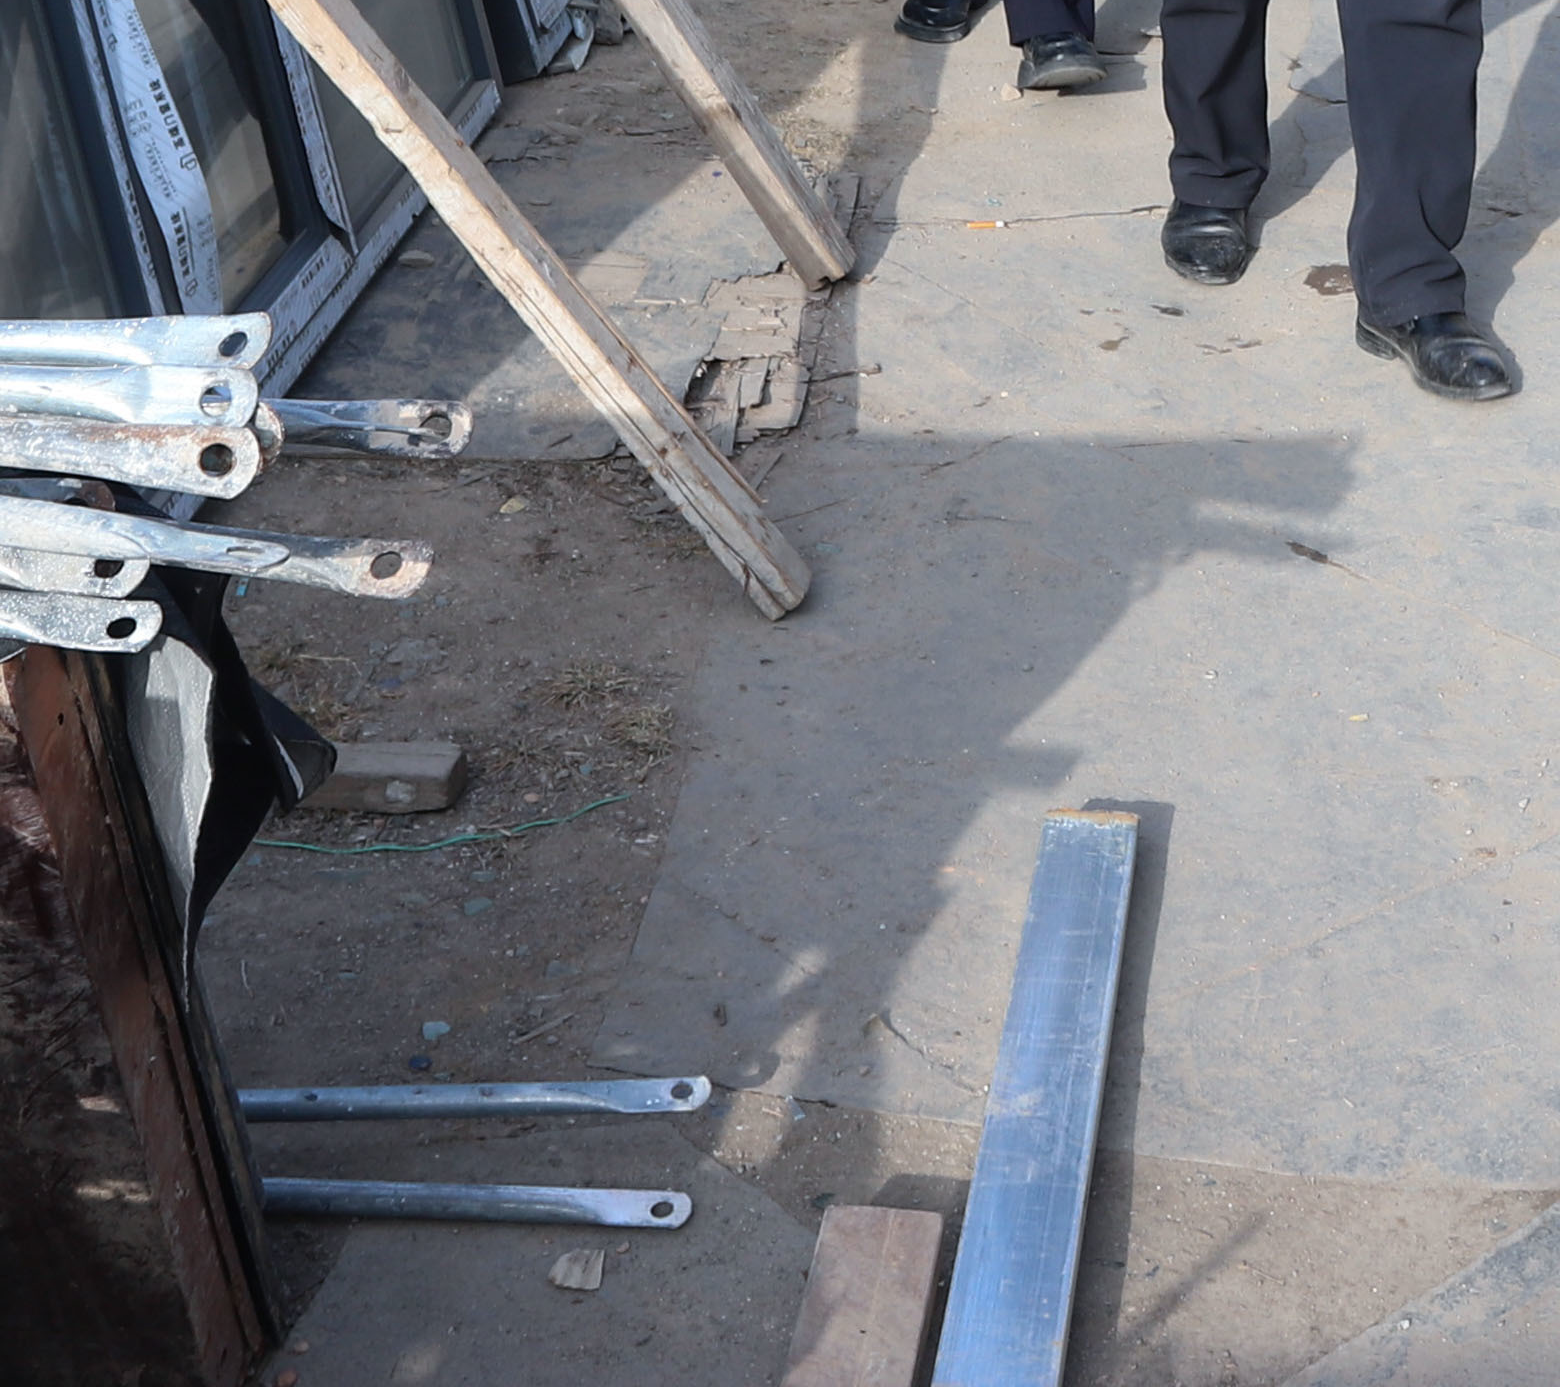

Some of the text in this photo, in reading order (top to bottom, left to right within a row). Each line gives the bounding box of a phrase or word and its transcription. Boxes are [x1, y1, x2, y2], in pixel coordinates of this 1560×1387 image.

[147, 77, 187, 149] 高端门窗系统
[166, 211, 194, 277] 高端门窗系统
